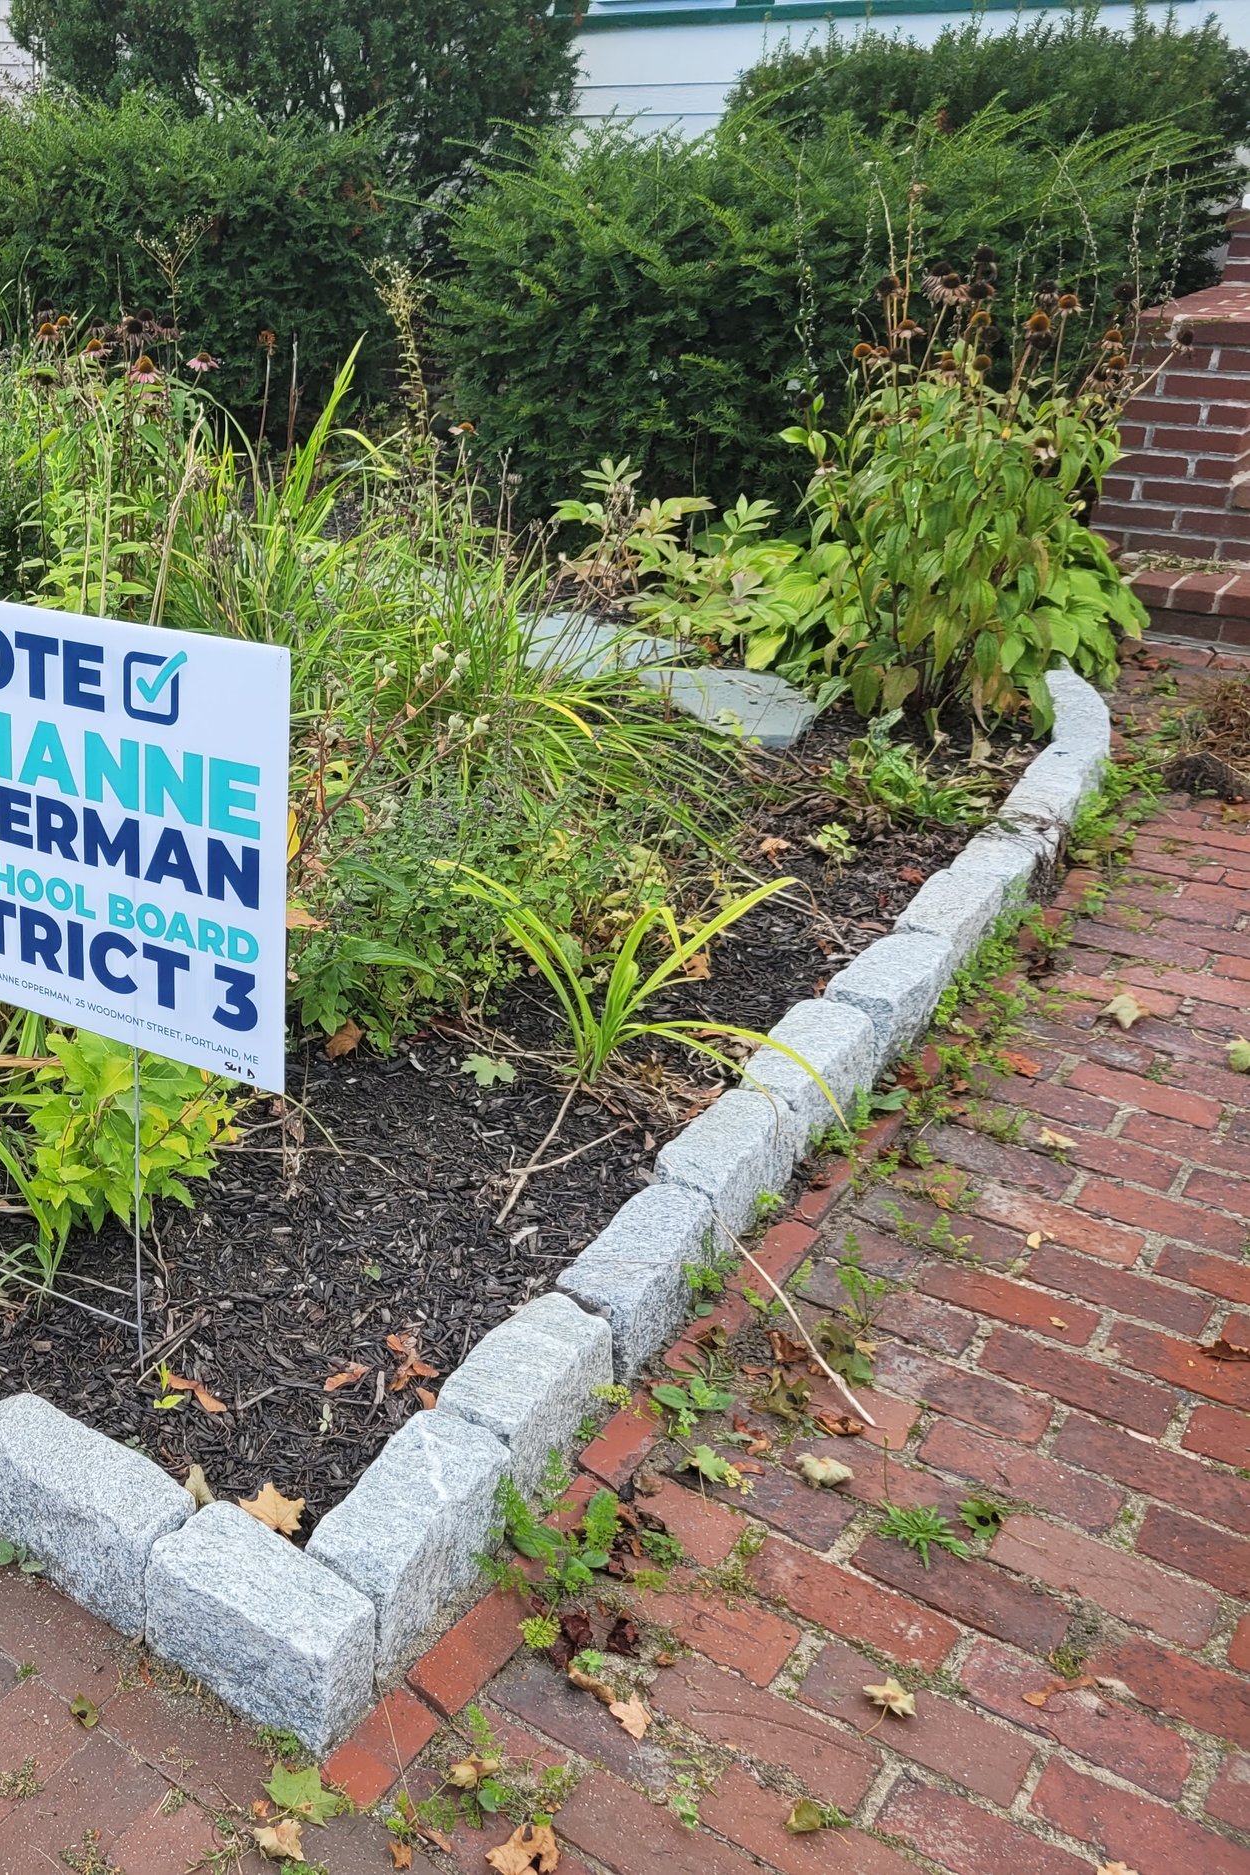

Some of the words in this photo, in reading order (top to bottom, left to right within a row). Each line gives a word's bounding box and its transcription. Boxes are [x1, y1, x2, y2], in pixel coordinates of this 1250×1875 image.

[109, 893, 260, 964] BOARD
[21, 980, 72, 1005] OPPERMAN,
[75, 997, 86, 1008] 25
[87, 1001, 145, 1028] WOODMONT
[146, 1022, 183, 1042] STREET,
[185, 1034, 241, 1060] PORTLAND,
[243, 1052, 259, 1064] ME
[212, 966, 259, 1032] 3
